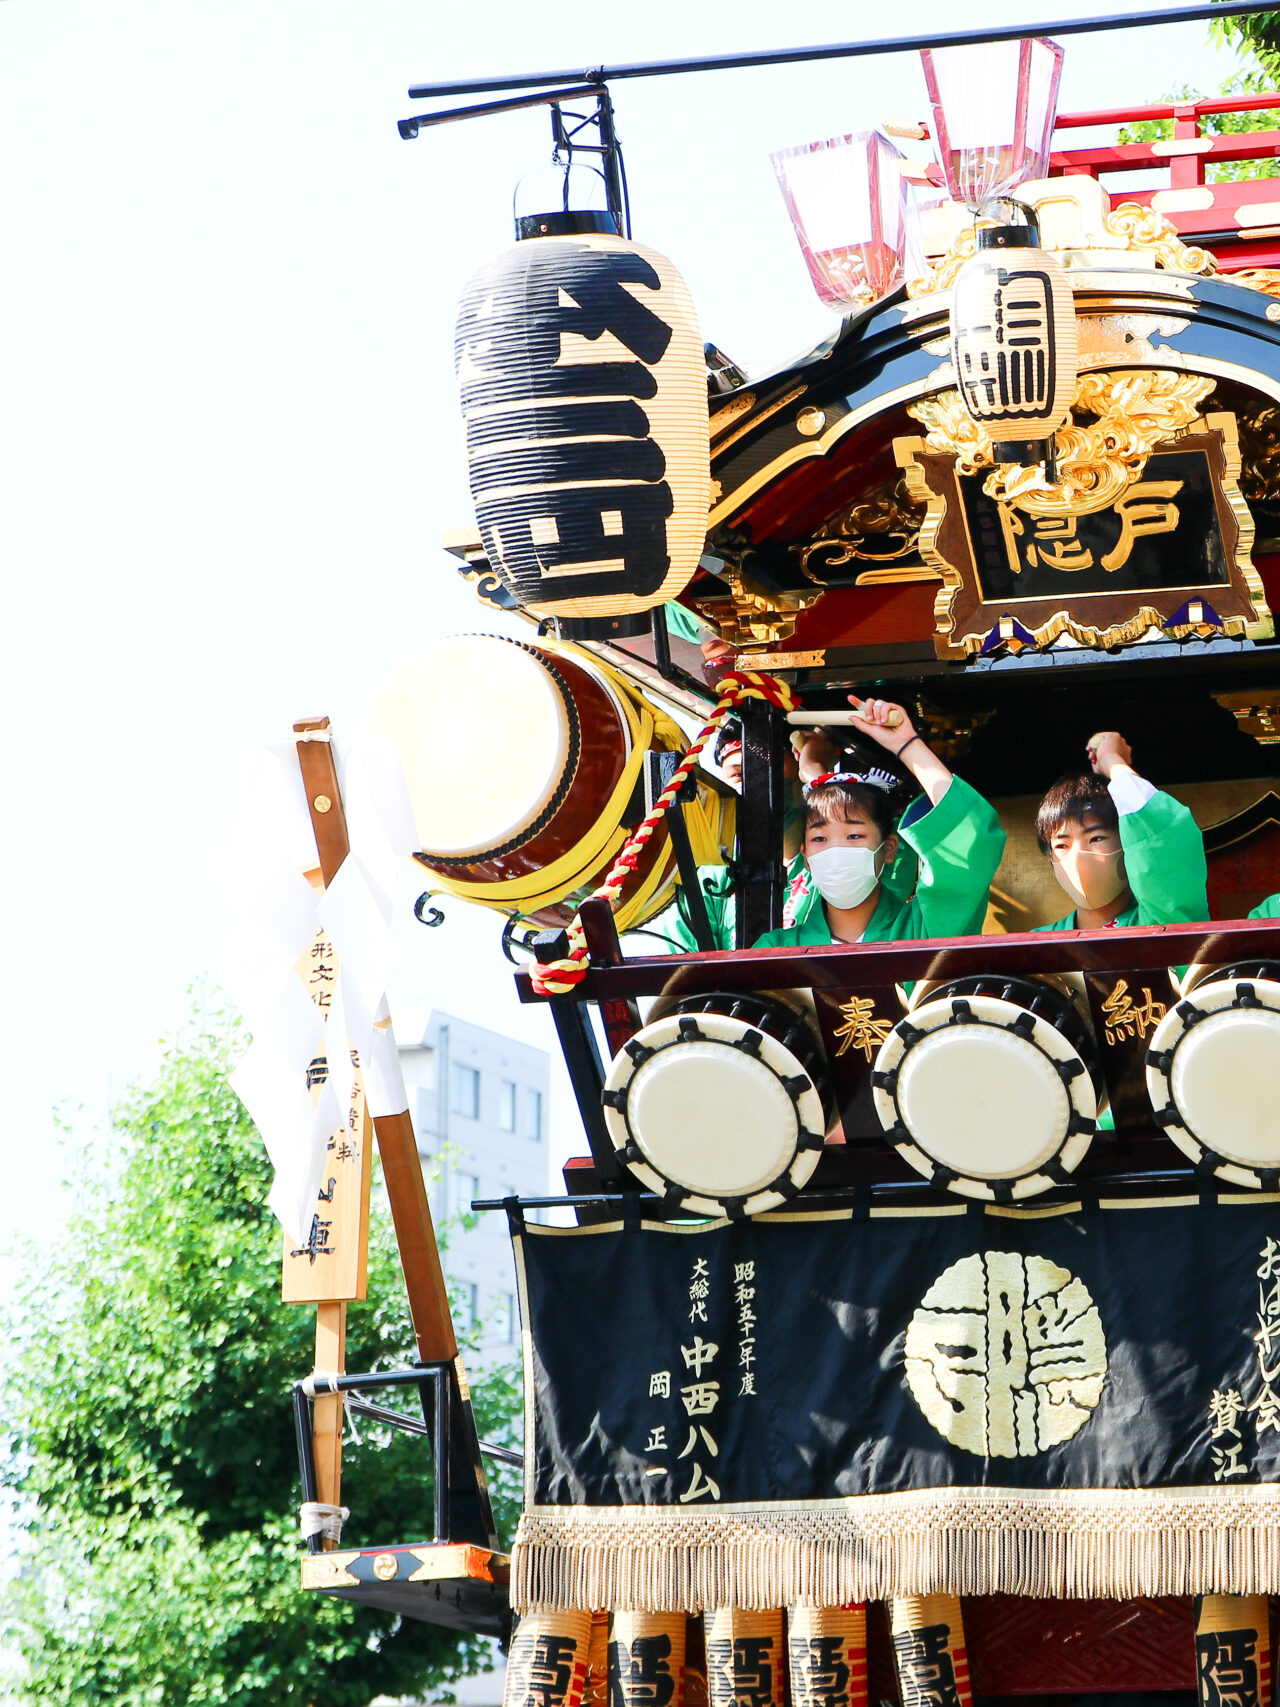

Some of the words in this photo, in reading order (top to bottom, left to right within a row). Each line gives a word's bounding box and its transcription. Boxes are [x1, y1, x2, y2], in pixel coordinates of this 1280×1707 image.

[308, 926, 335, 1023] 形文化
[833, 996, 894, 1063] 奉
[1101, 978, 1167, 1046] 納
[688, 1257, 710, 1325] 大総代
[733, 1260, 758, 1397] 昭和五十一年度
[644, 1370, 672, 1478] 岡正一
[1190, 1593, 1259, 1707] 隠
